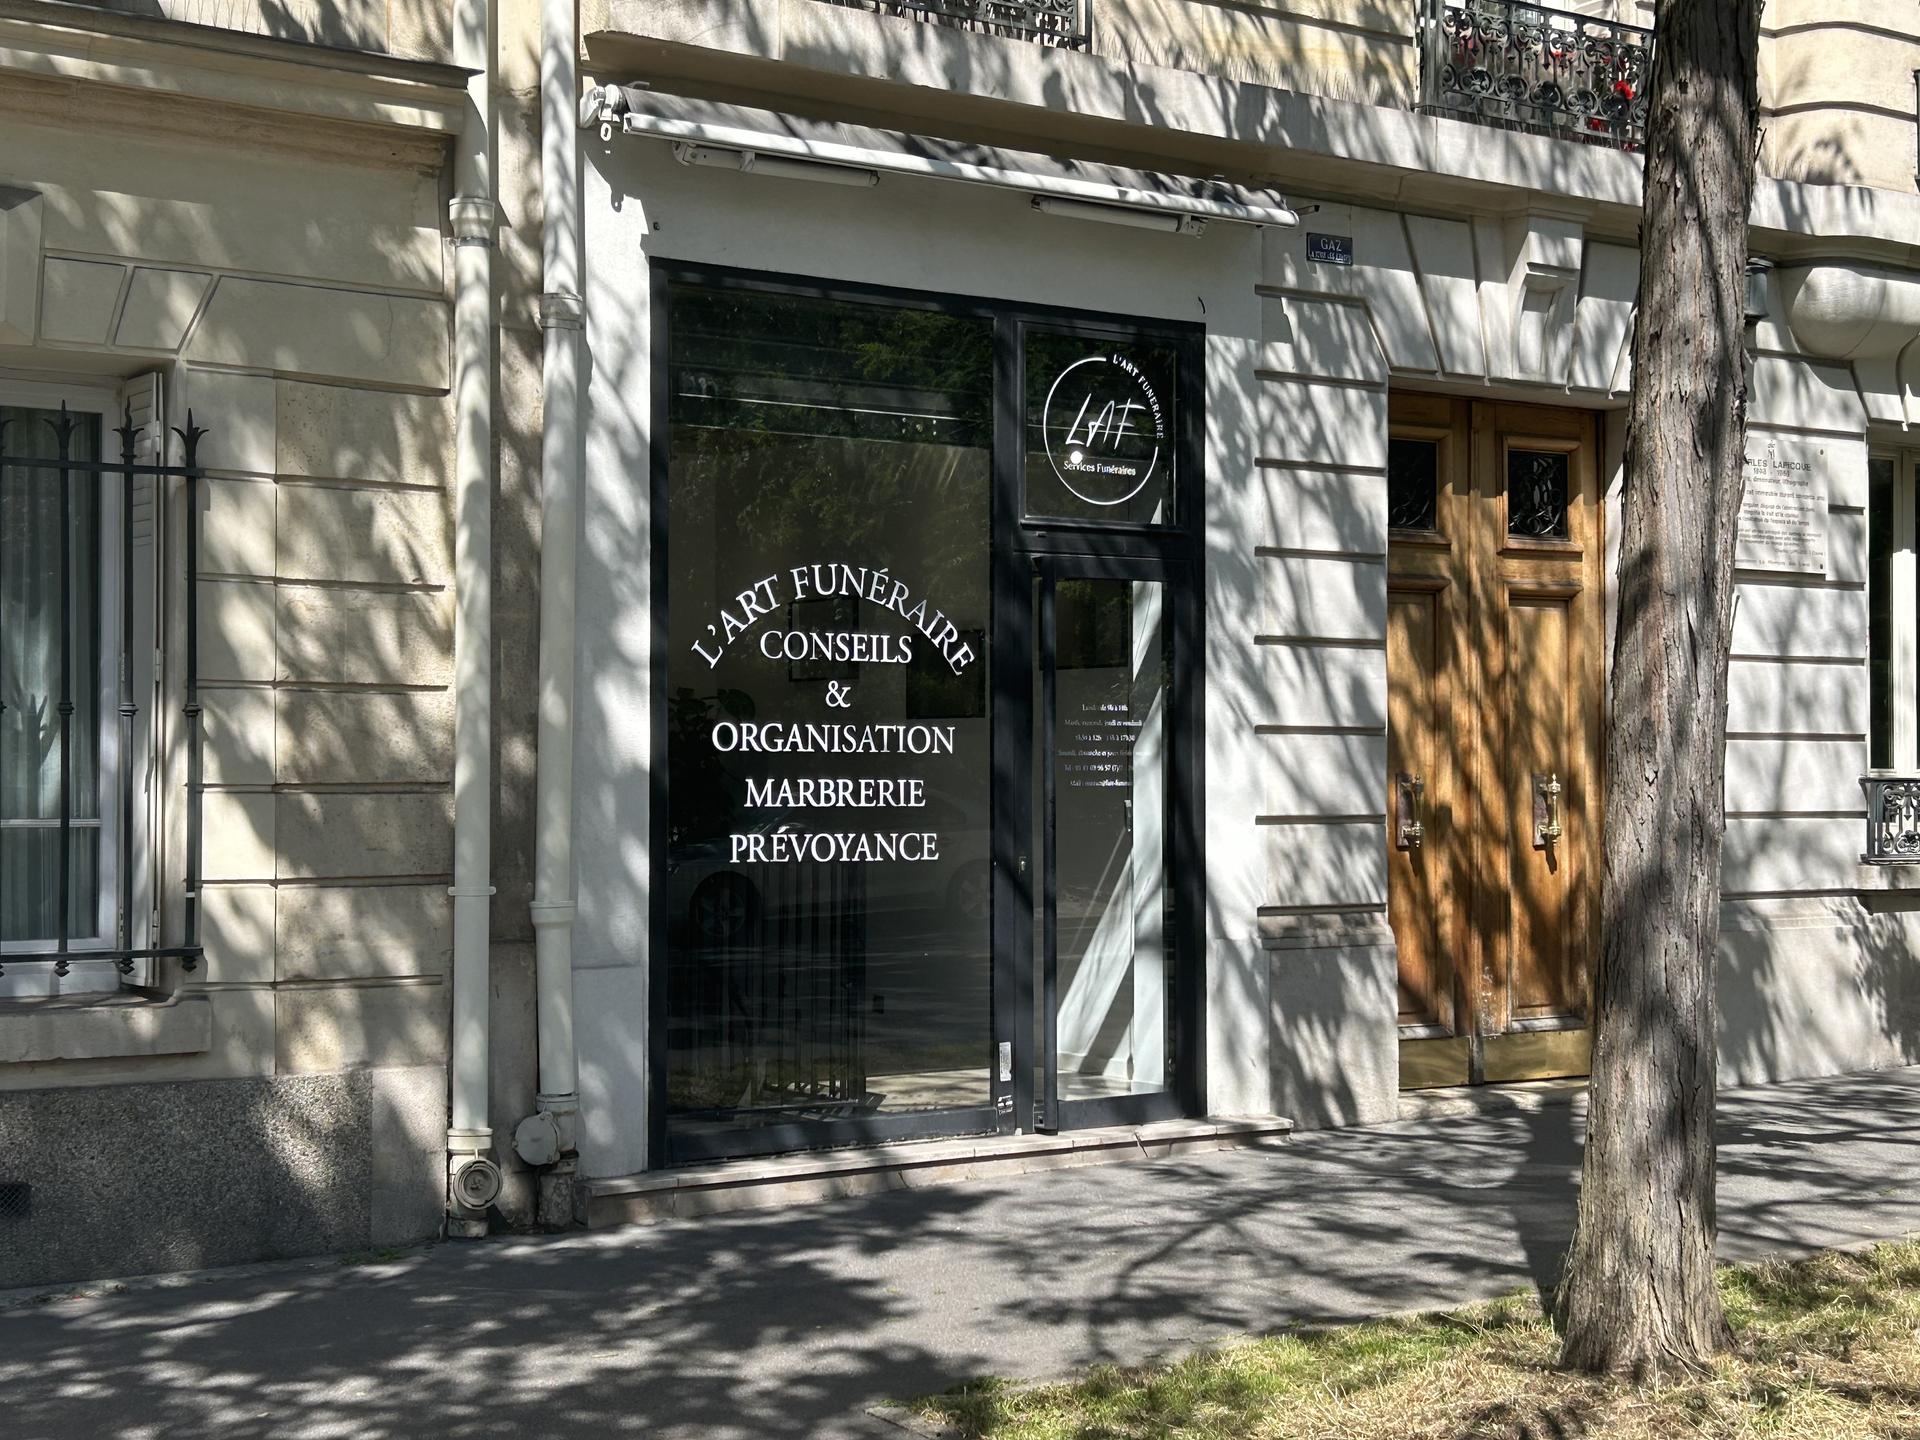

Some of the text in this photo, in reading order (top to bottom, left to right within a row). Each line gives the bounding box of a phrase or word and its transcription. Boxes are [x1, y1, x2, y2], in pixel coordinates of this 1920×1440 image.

[1320, 238, 1342, 252] GAZ
[1112, 354, 1139, 377] L'ART
[1063, 460, 1137, 476] Services Funéraires
[691, 563, 975, 676] L'ART FUNÉRAIRE
[760, 630, 912, 664] CONSEILS
[825, 680, 851, 708] &
[711, 722, 956, 754] ORGANISATION
[743, 778, 926, 808] MARBRERIE
[729, 826, 939, 863] PRÉVOYANCE
